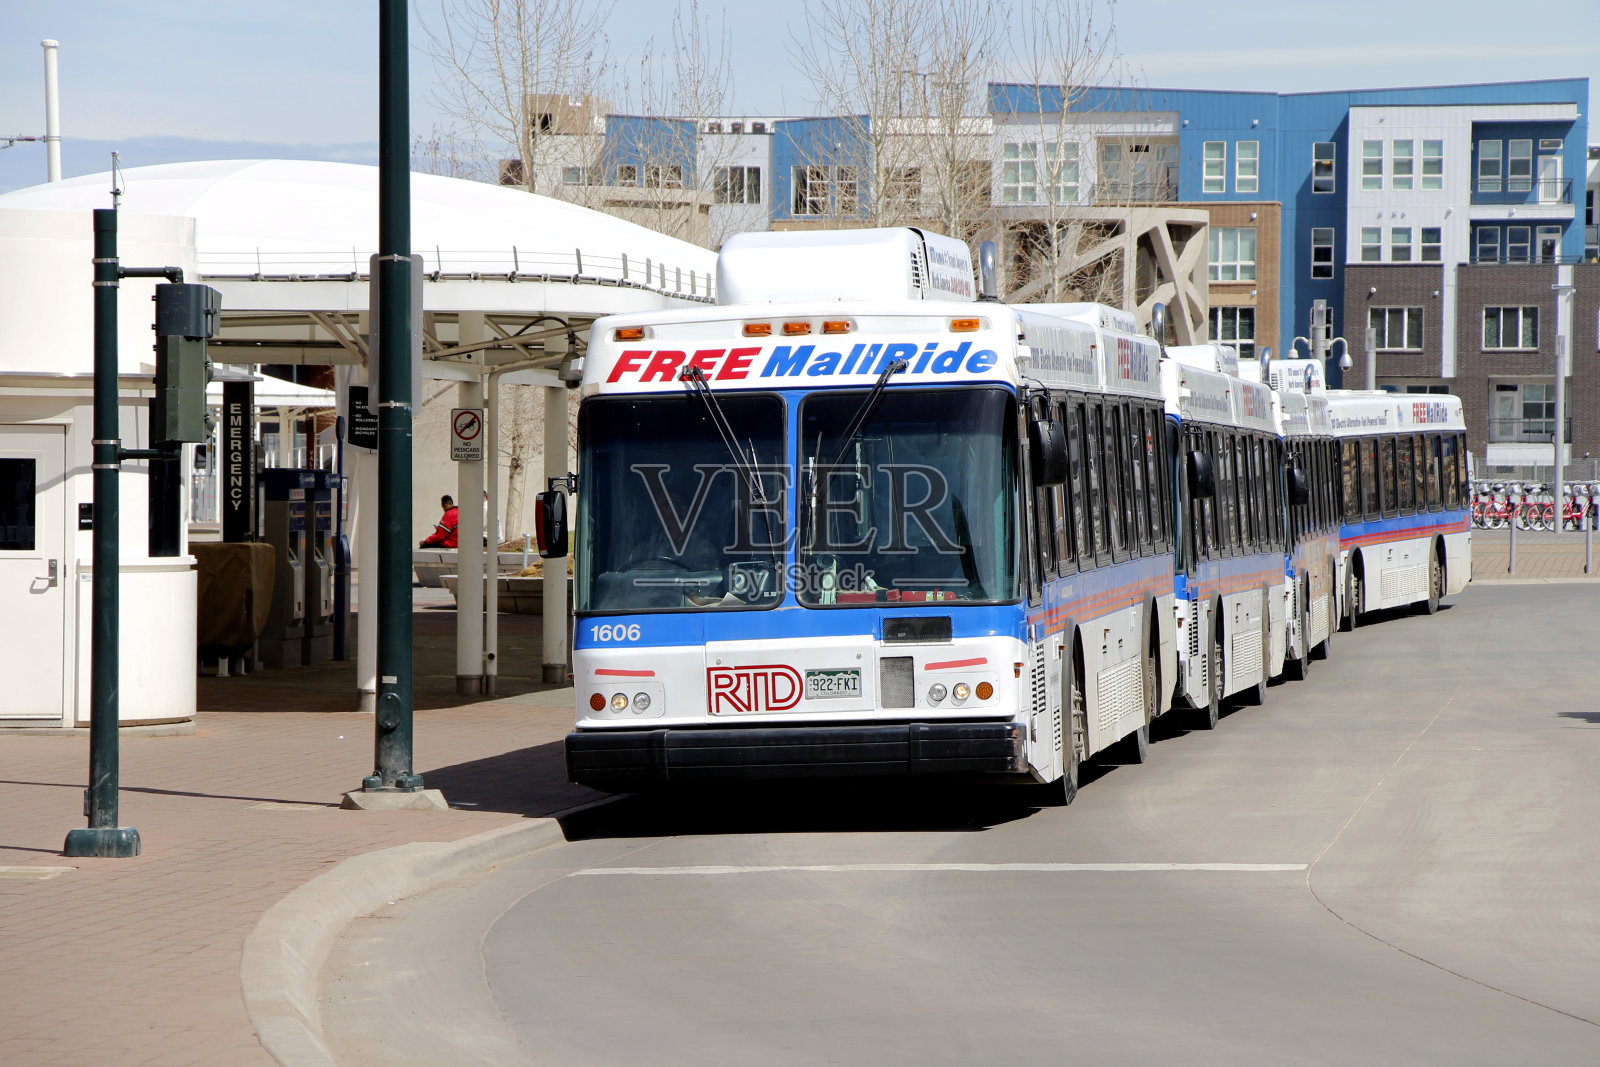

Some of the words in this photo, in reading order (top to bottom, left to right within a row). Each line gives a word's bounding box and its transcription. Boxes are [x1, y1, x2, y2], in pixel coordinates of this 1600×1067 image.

[606, 346, 762, 383] FREE
[760, 341, 998, 378] MallRide
[1412, 402, 1426, 424] FREE
[230, 403, 242, 510] EMERGENCY
[590, 624, 641, 642] 1606
[706, 664, 804, 713] RTD
